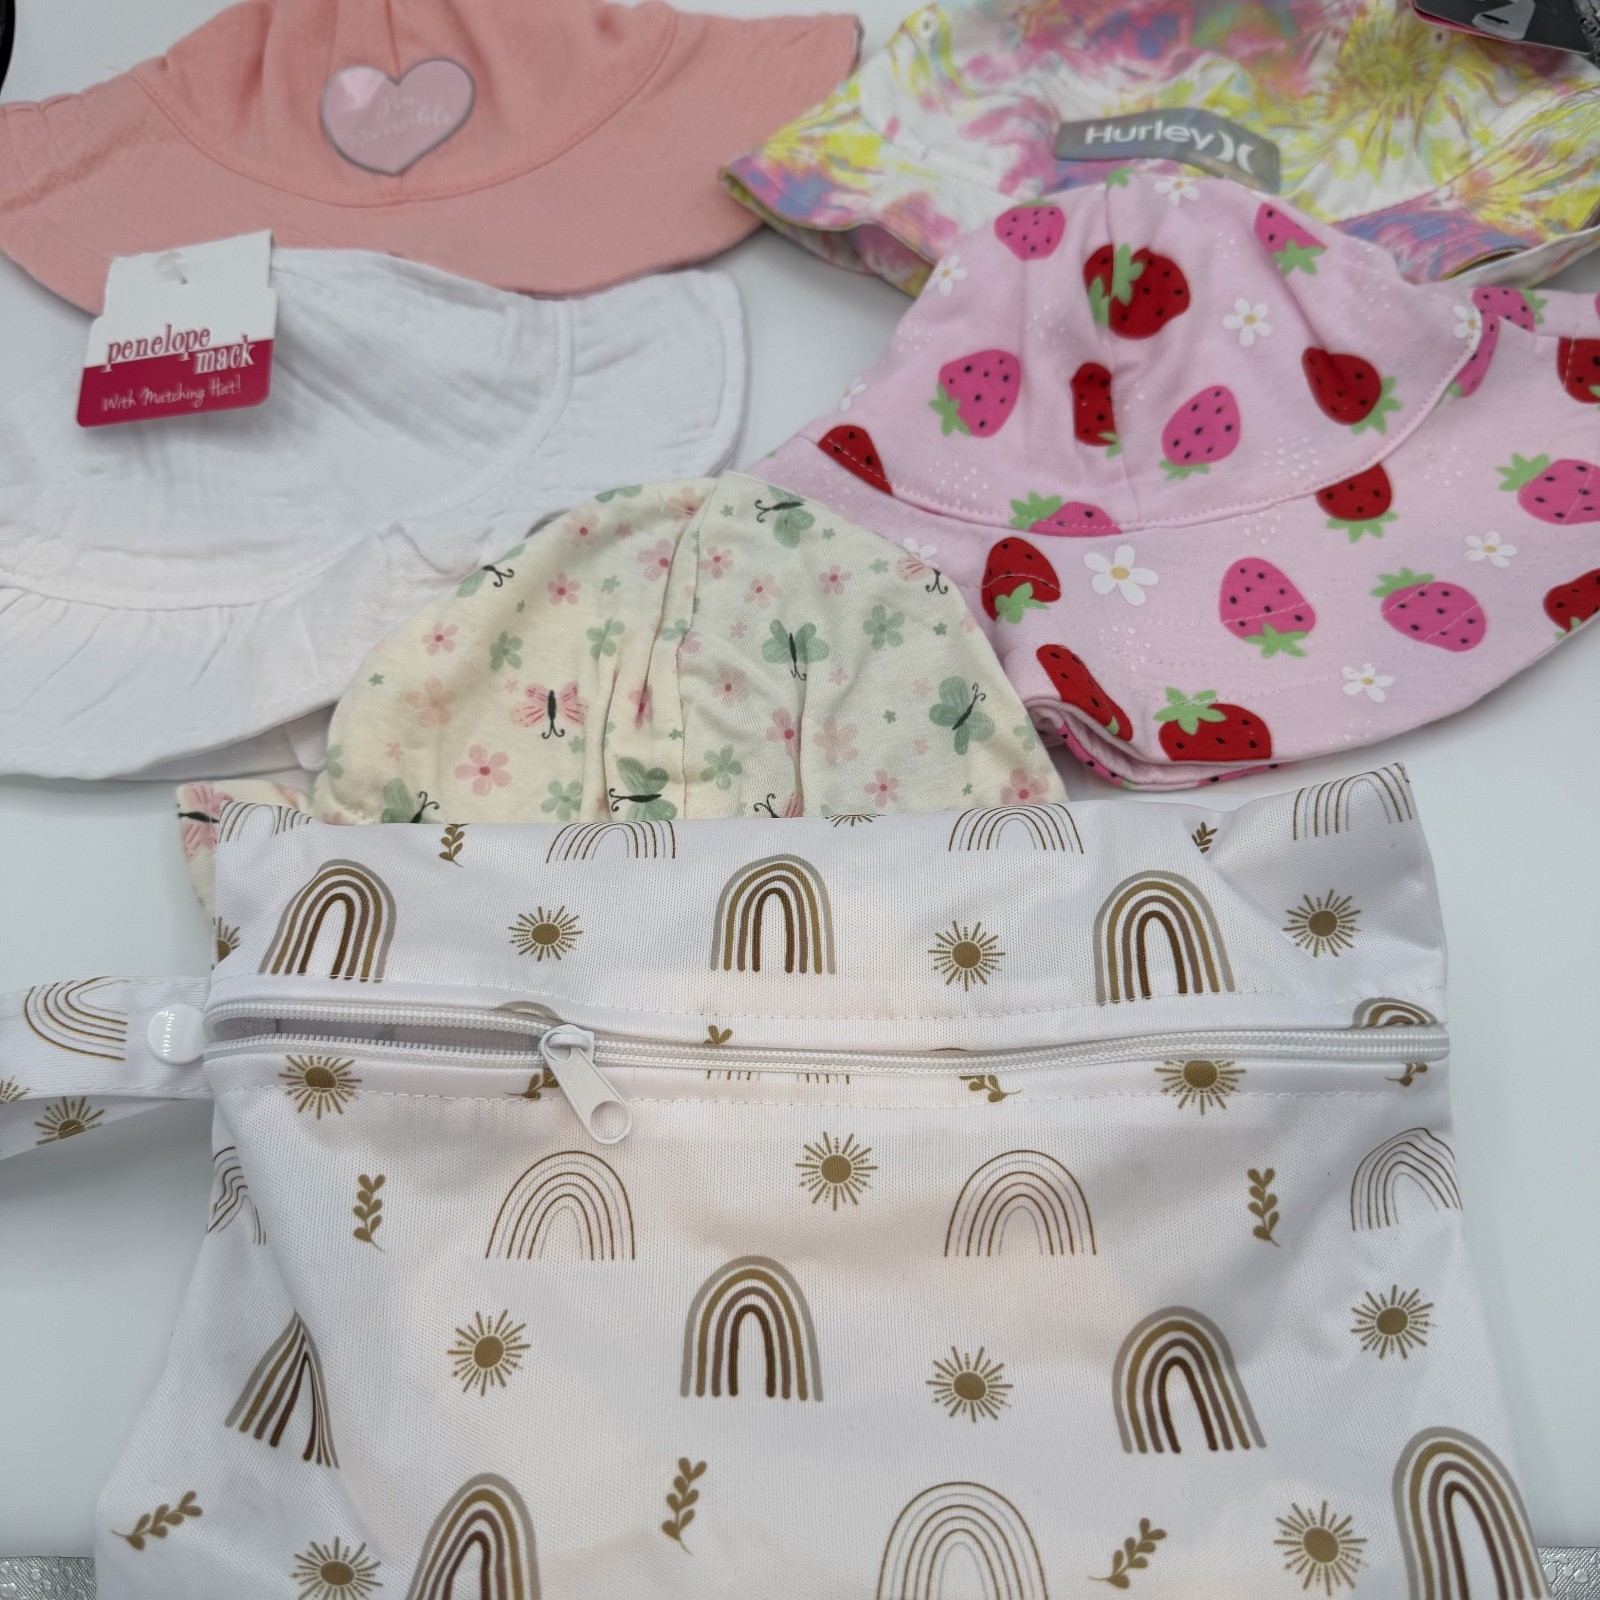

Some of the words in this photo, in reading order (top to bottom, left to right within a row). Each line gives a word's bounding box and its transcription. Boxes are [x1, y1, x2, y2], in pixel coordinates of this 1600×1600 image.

[1084, 120, 1215, 151] Hurley
[101, 323, 212, 373] penelope
[193, 334, 256, 374] mack
[140, 382, 206, 409] Matching
[209, 374, 242, 397] Hat!
